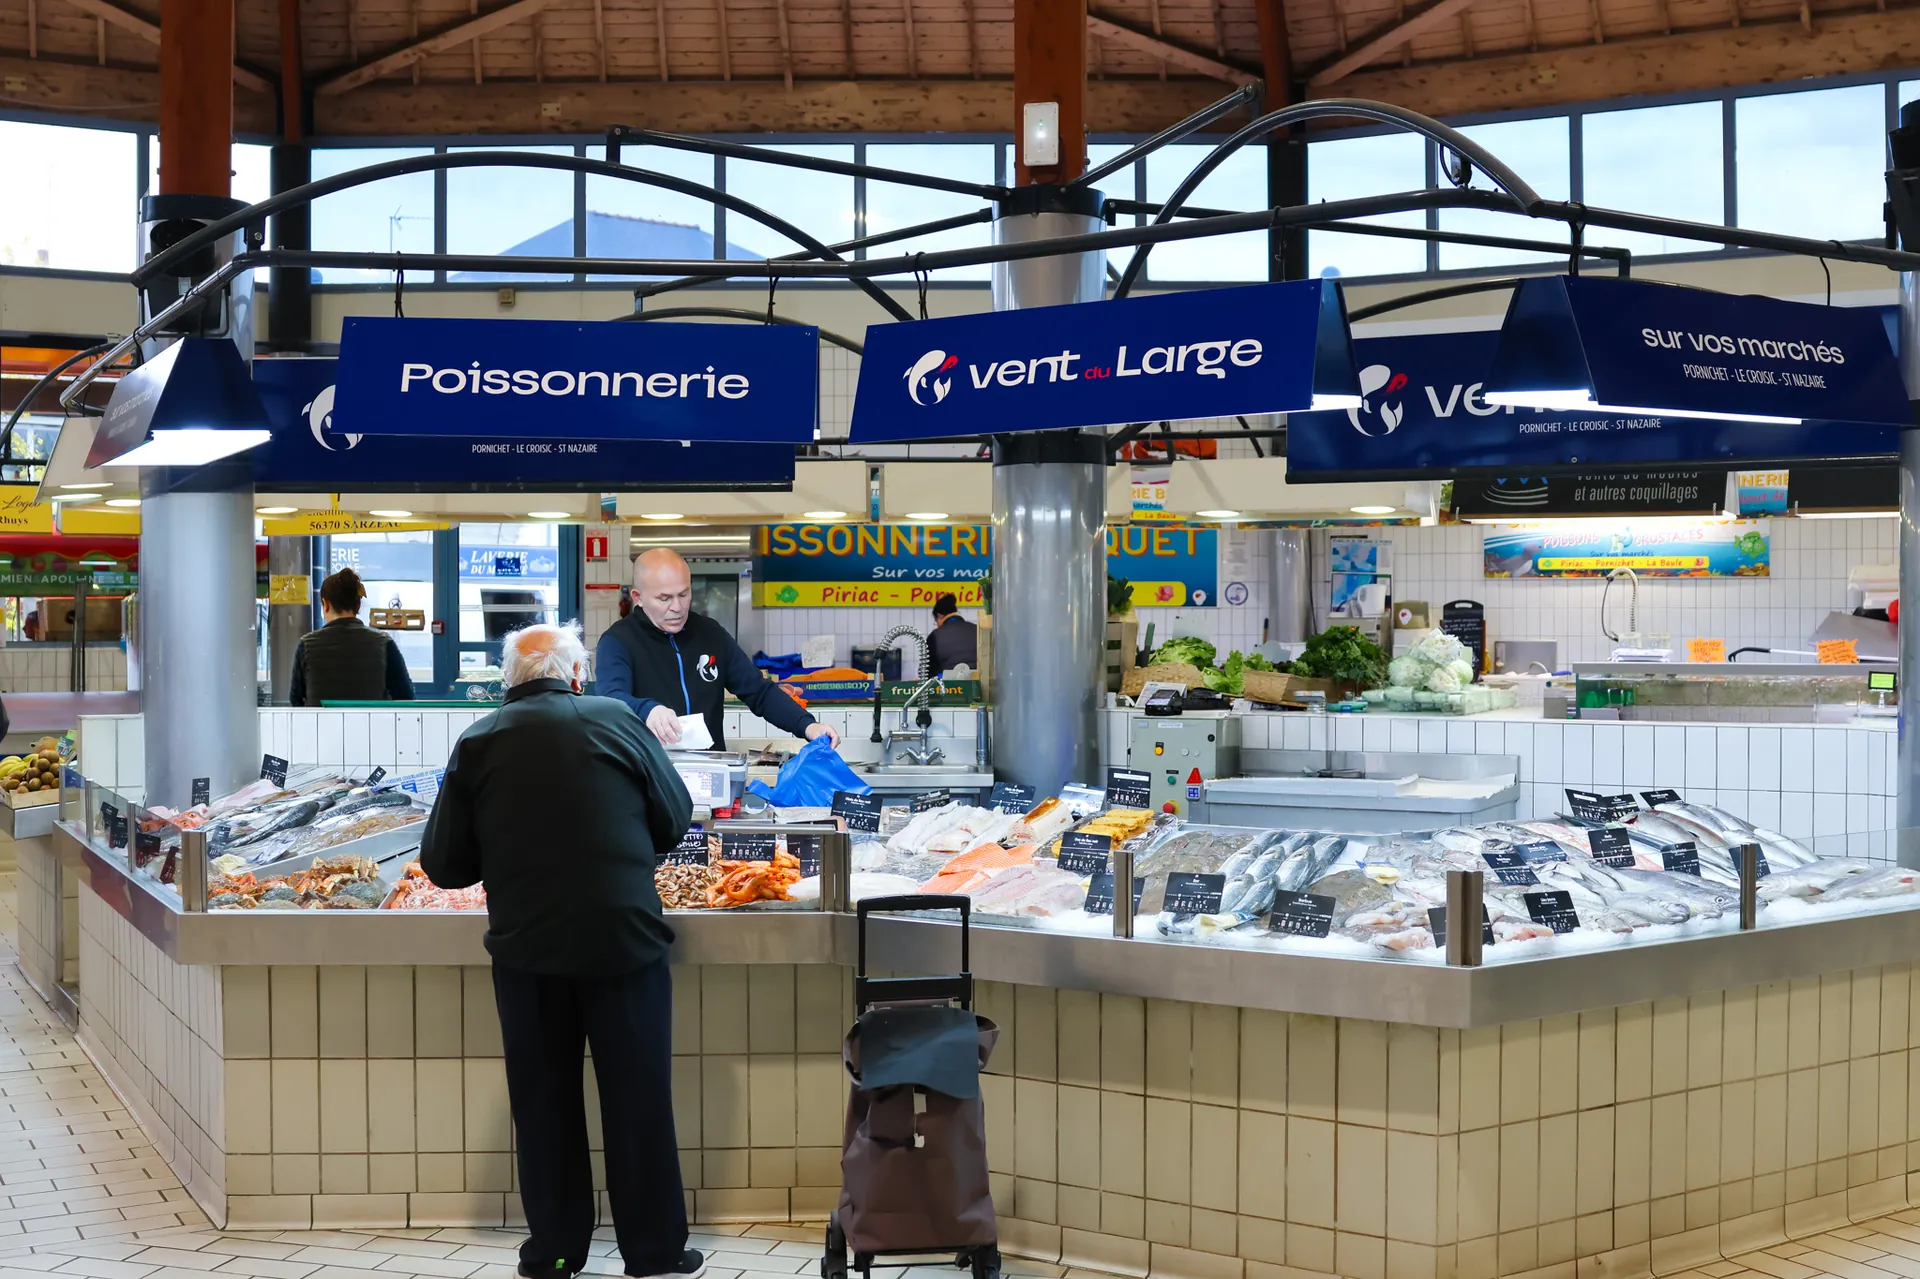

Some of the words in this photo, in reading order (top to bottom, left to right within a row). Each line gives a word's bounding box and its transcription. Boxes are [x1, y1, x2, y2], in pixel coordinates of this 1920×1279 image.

[1642, 328, 1682, 350] sur
[1687, 331, 1736, 354] vos
[1737, 337, 1845, 366] marchés
[969, 350, 1081, 389] vent
[1084, 365, 1111, 379] du
[1117, 338, 1263, 379] Large
[401, 360, 750, 399] Poissonnerie
[1683, 363, 1730, 381] PORNICHET
[1735, 369, 1747, 383] LE
[1747, 370, 1777, 385] CROISIC
[1781, 373, 1793, 386] ST
[1793, 374, 1827, 388] NAZAIRE
[1519, 422, 1562, 434] PORNICHET
[1568, 421, 1578, 431] LE
[1579, 420, 1609, 431] CROISIC
[1616, 419, 1625, 430] ST
[1627, 417, 1661, 429] NAZAIRE
[472, 444, 510, 454] PORNICHET
[516, 444, 526, 453] LE
[528, 444, 552, 453] CROISIC
[558, 444, 566, 453] ST
[567, 444, 598, 453] NAZAIRE
[1574, 487, 1586, 501] et
[1590, 484, 1626, 501] autres
[1629, 482, 1699, 503] coquillages
[309, 520, 341, 531] 56370
[343, 519, 402, 529] SARZEAU
[1543, 533, 1600, 549] POISSONS
[1560, 559, 1584, 568] Piriac
[1595, 559, 1635, 568] Pornichet
[1646, 559, 1657, 567] La
[1660, 558, 1683, 567] Baule
[872, 566, 908, 579] Sur
[914, 568, 945, 579] vos
[822, 586, 879, 603] Piriac
